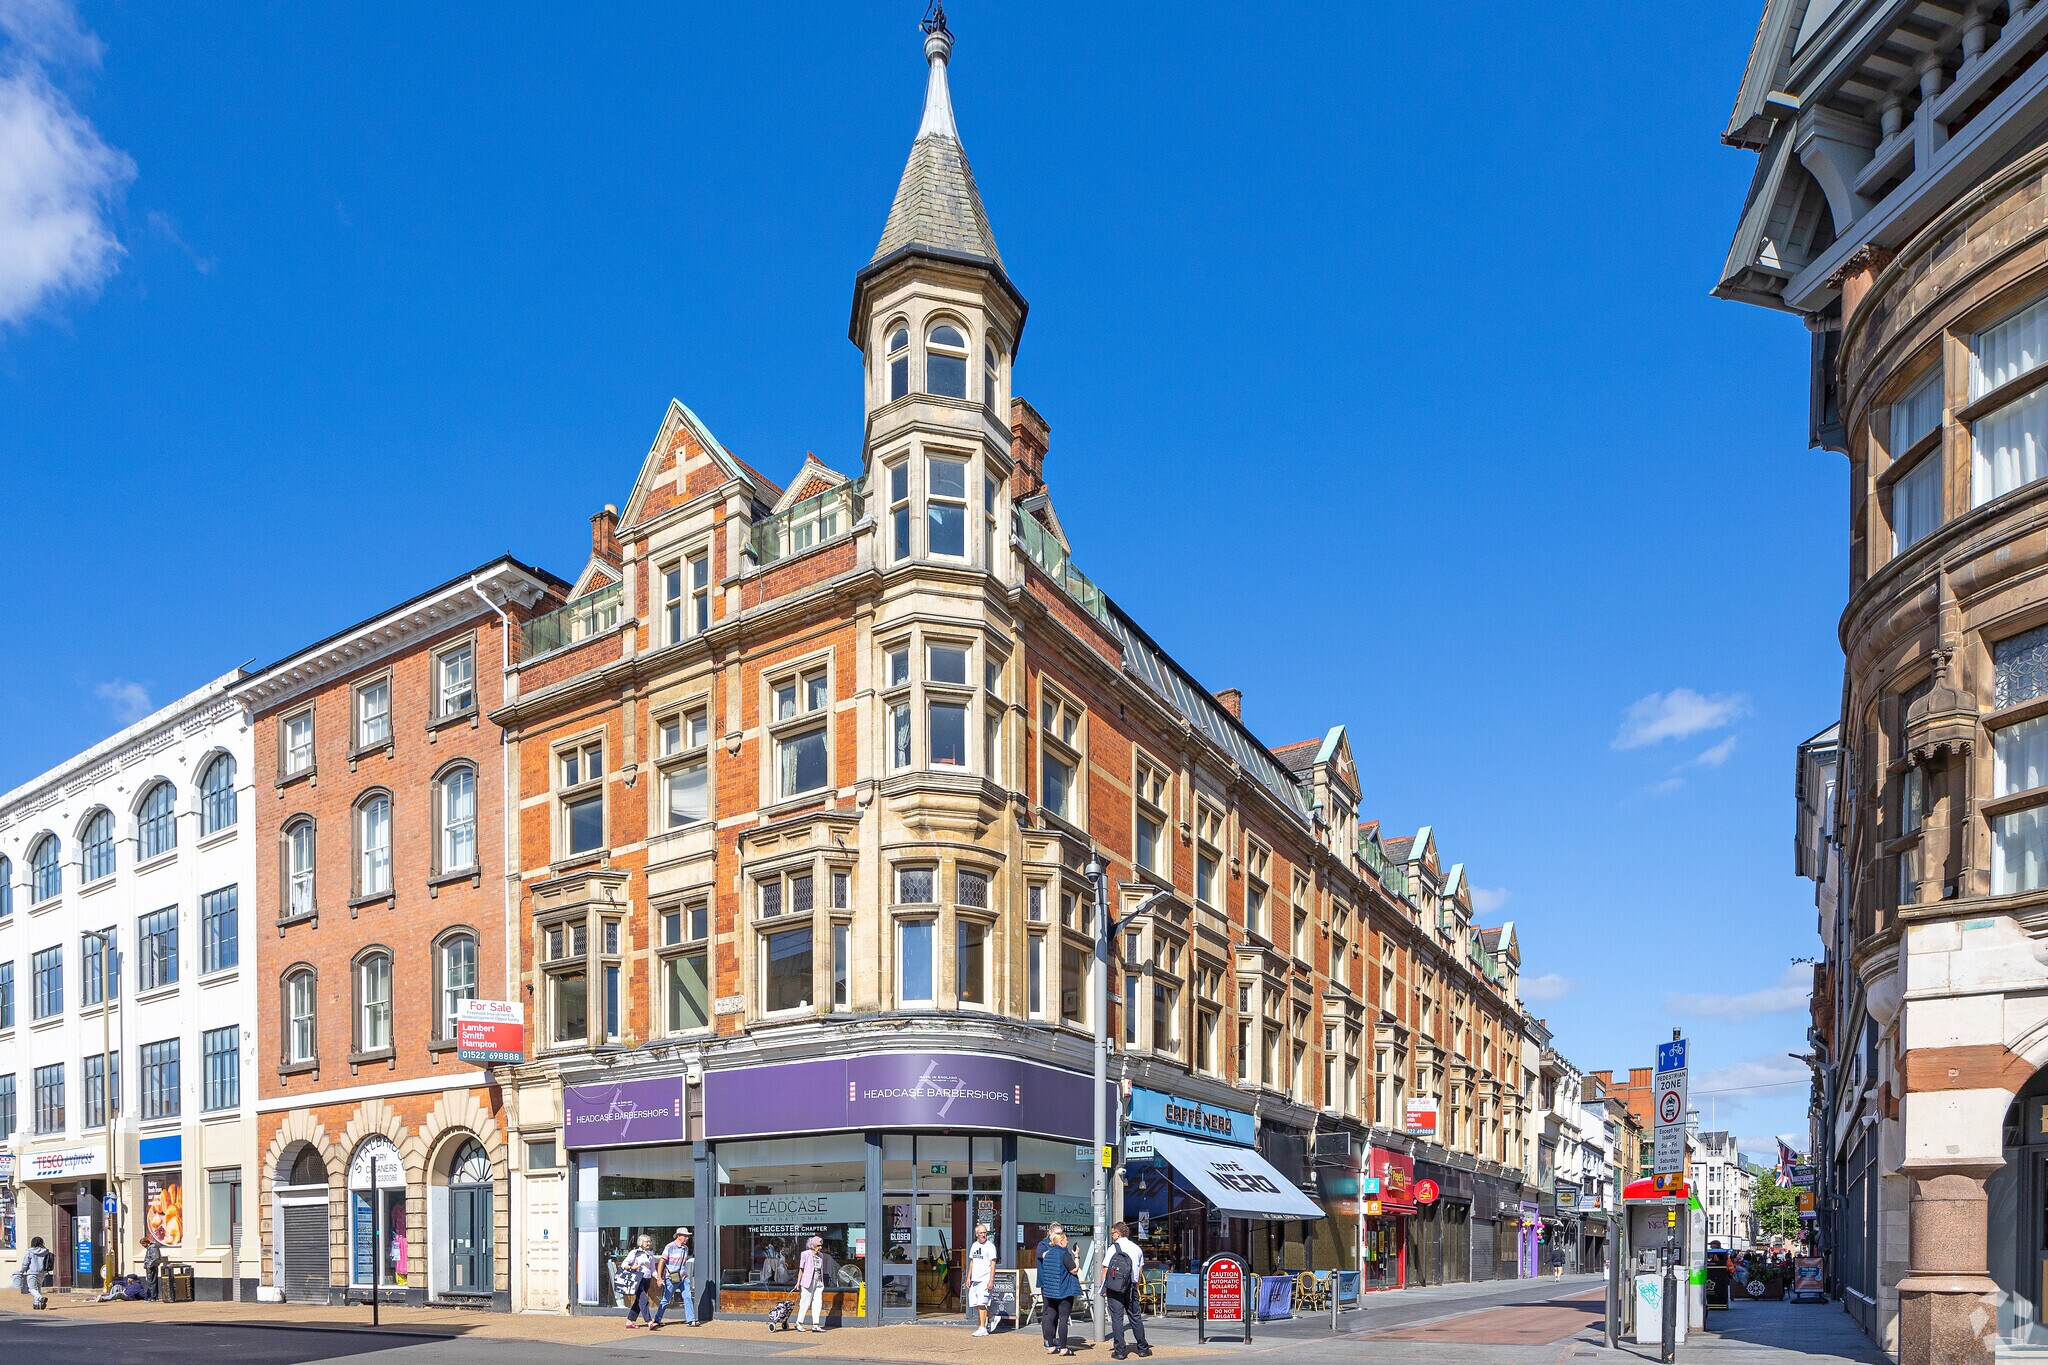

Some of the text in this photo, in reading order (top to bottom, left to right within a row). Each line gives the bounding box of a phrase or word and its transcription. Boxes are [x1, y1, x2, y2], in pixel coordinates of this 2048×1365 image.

[470, 1001, 511, 1012] For Sale
[462, 1023, 495, 1032] Lambert
[462, 1031, 484, 1039] Smith
[462, 1039, 497, 1049] Hampton
[462, 1051, 486, 1059] 01522
[1657, 1071, 1686, 1082] PEDESTRIAN
[1661, 1079, 1681, 1090] ZONE
[864, 1089, 1009, 1101] HEADCASE BARBERSHOPS
[576, 1108, 669, 1124] HEADCASE BARBERSHOPS
[1201, 1113, 1232, 1132] NERO
[36, 1153, 94, 1170] TESCO express
[366, 1163, 398, 1173] CANERS
[1206, 1170, 1281, 1194] NERO
[748, 1197, 827, 1213] HEADCASE
[890, 1233, 911, 1241] CLOSED
